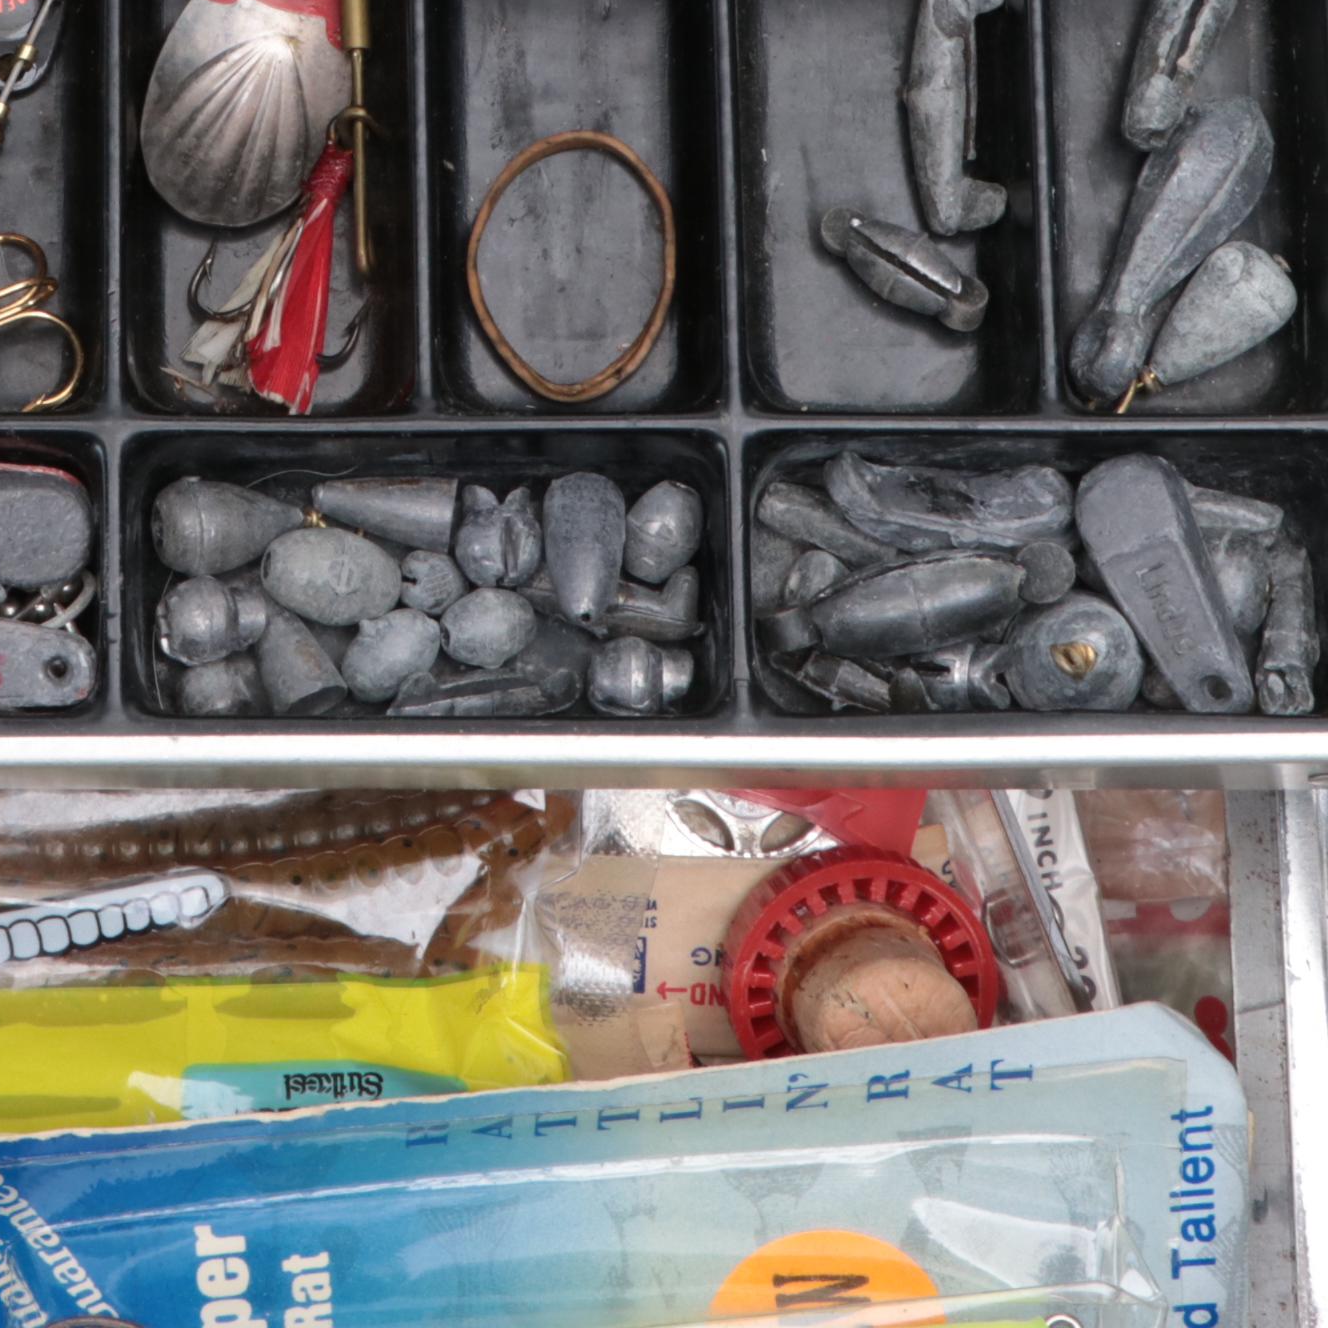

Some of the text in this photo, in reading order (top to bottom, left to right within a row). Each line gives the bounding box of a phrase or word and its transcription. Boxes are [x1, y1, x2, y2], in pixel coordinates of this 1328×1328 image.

[866, 1058, 1034, 1104] RAT
[1170, 1104, 1218, 1281] Talient
[282, 1251, 334, 1328] Rat
